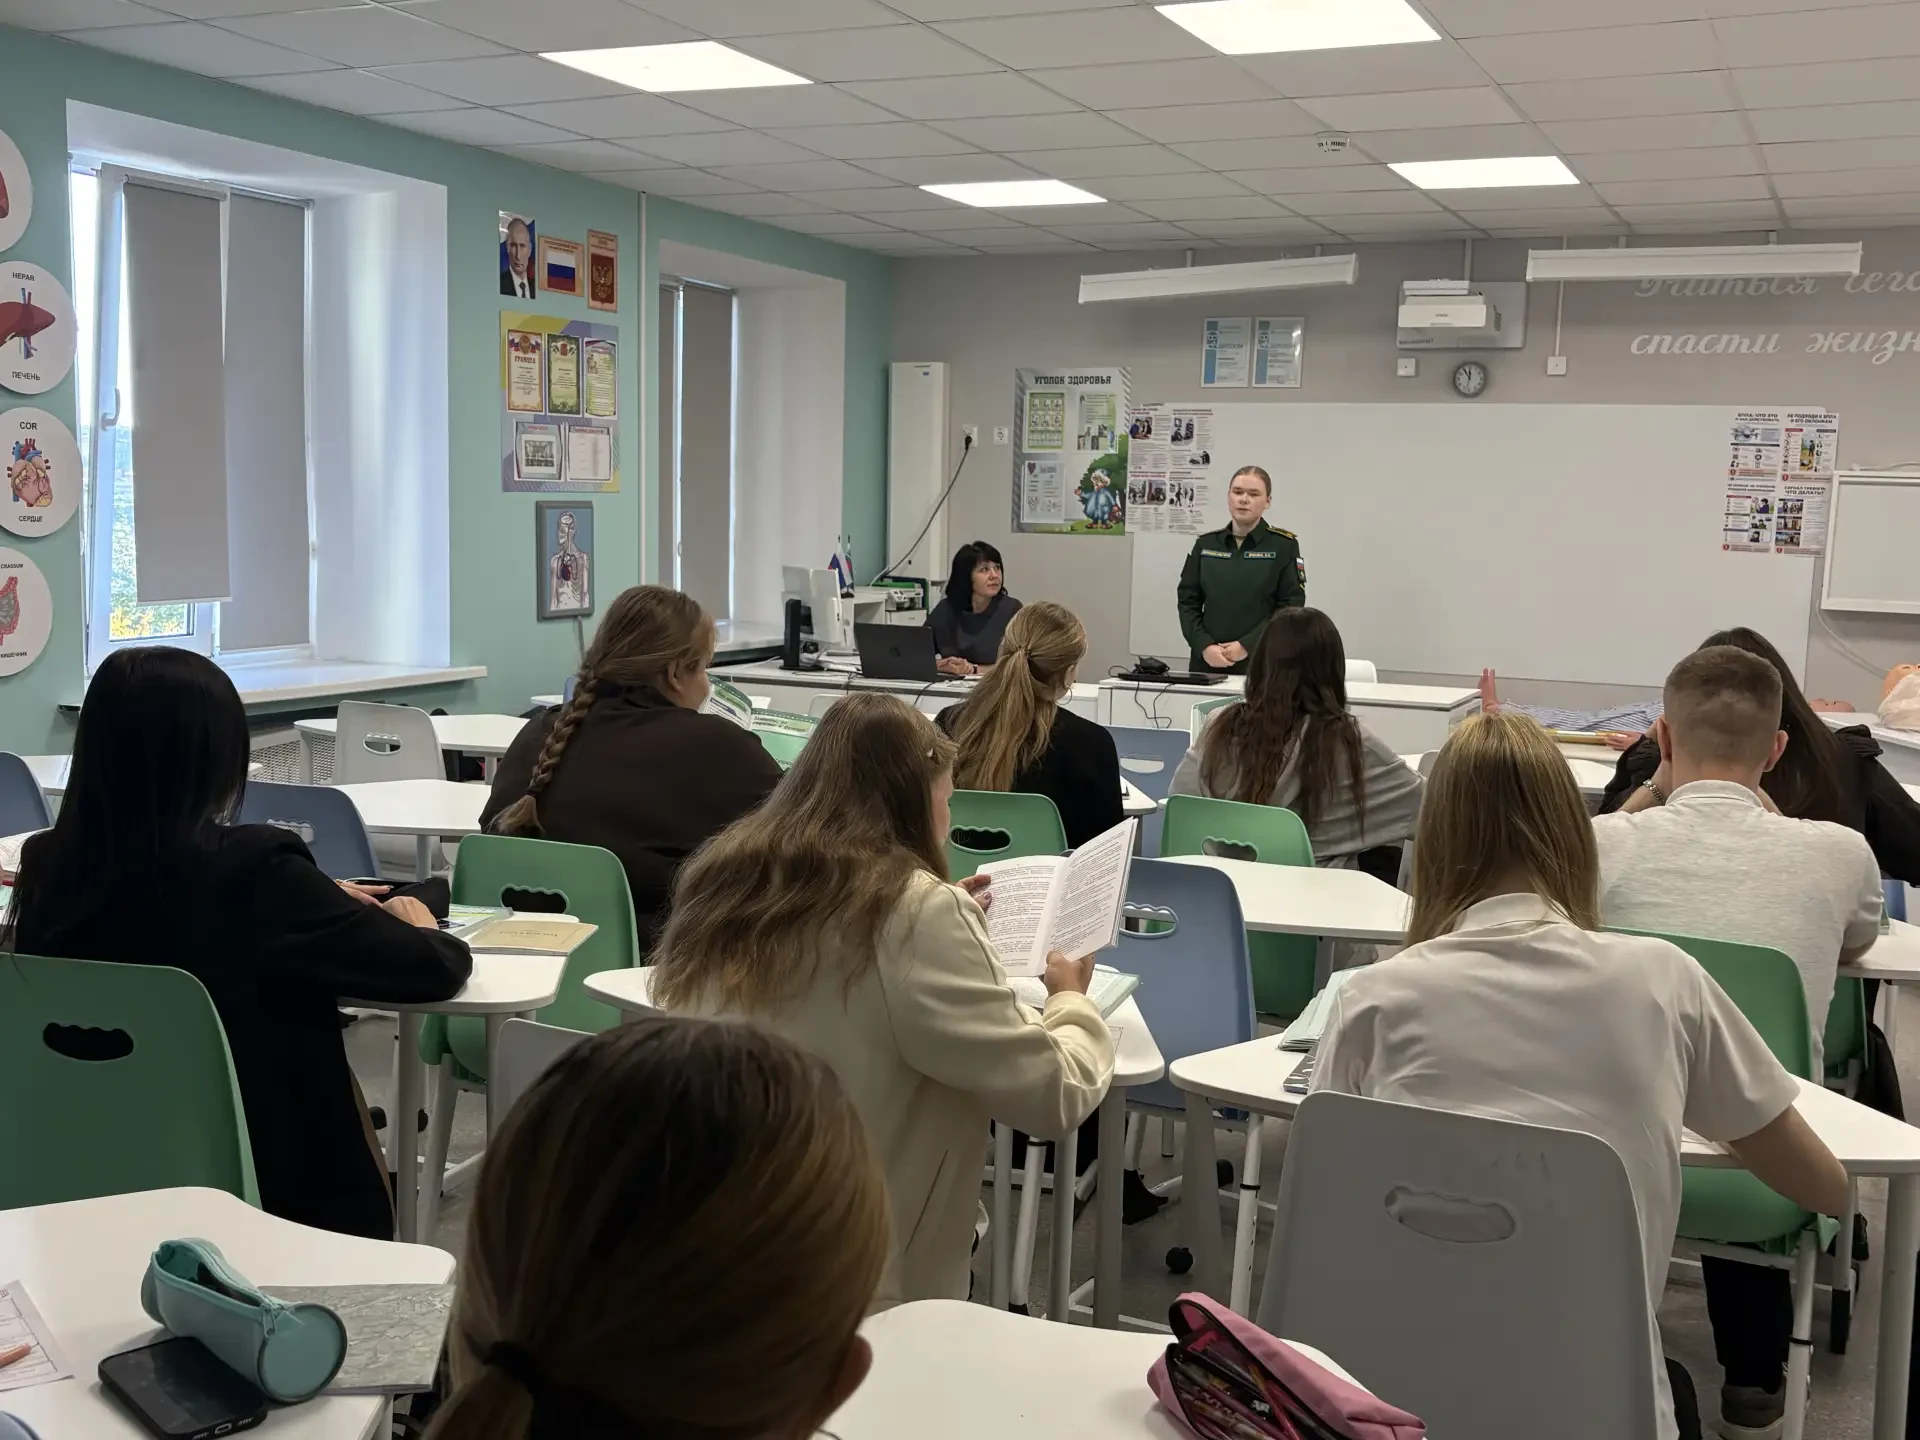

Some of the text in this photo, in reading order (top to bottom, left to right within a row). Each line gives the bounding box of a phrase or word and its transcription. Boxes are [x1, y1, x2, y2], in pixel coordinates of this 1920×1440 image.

[12, 271, 35, 281] HEPAR
[1630, 333, 1780, 354] спасти
[12, 371, 41, 381] ПЕЧЕНЬ
[1034, 375, 1112, 386] УГОЛОК ЗДОРОВЬЯ
[19, 421, 38, 430] COR
[18, 515, 43, 523] СЕРДЦЕ
